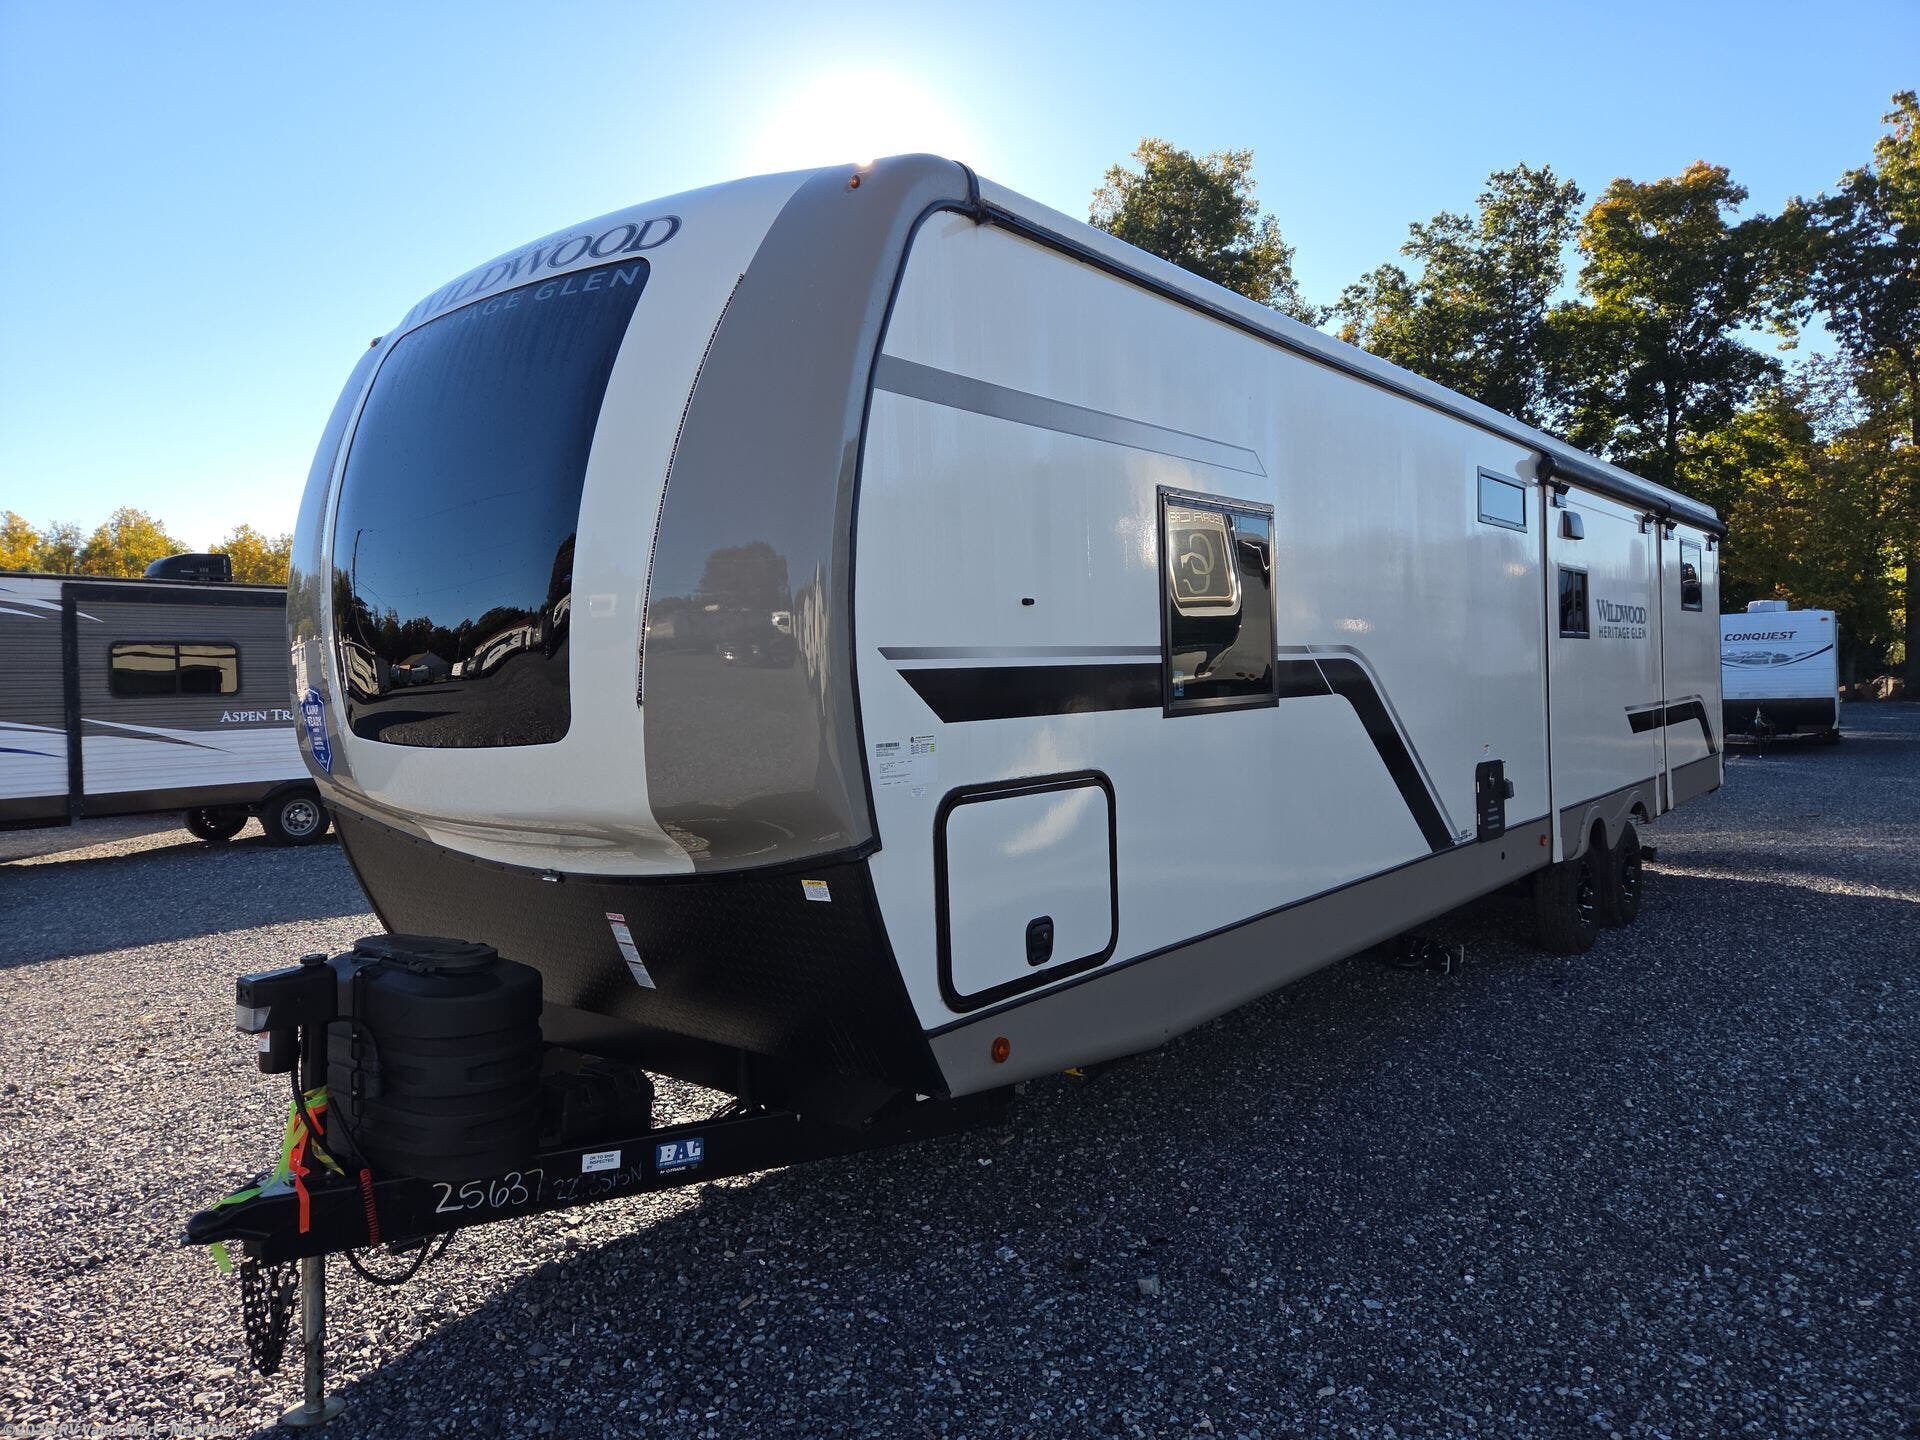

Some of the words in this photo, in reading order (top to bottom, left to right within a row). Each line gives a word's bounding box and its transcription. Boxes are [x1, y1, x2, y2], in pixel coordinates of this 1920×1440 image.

[533, 265, 641, 301] GLEN
[1597, 599, 1646, 624] WILDWOOD
[1599, 626, 1630, 639] HERITAGE
[1631, 626, 1647, 640] GLEN
[1724, 631, 1797, 642] CONQUEST
[220, 709, 267, 723] ASPEN
[659, 1141, 701, 1163] BAL
[434, 1169, 543, 1213] 25637
